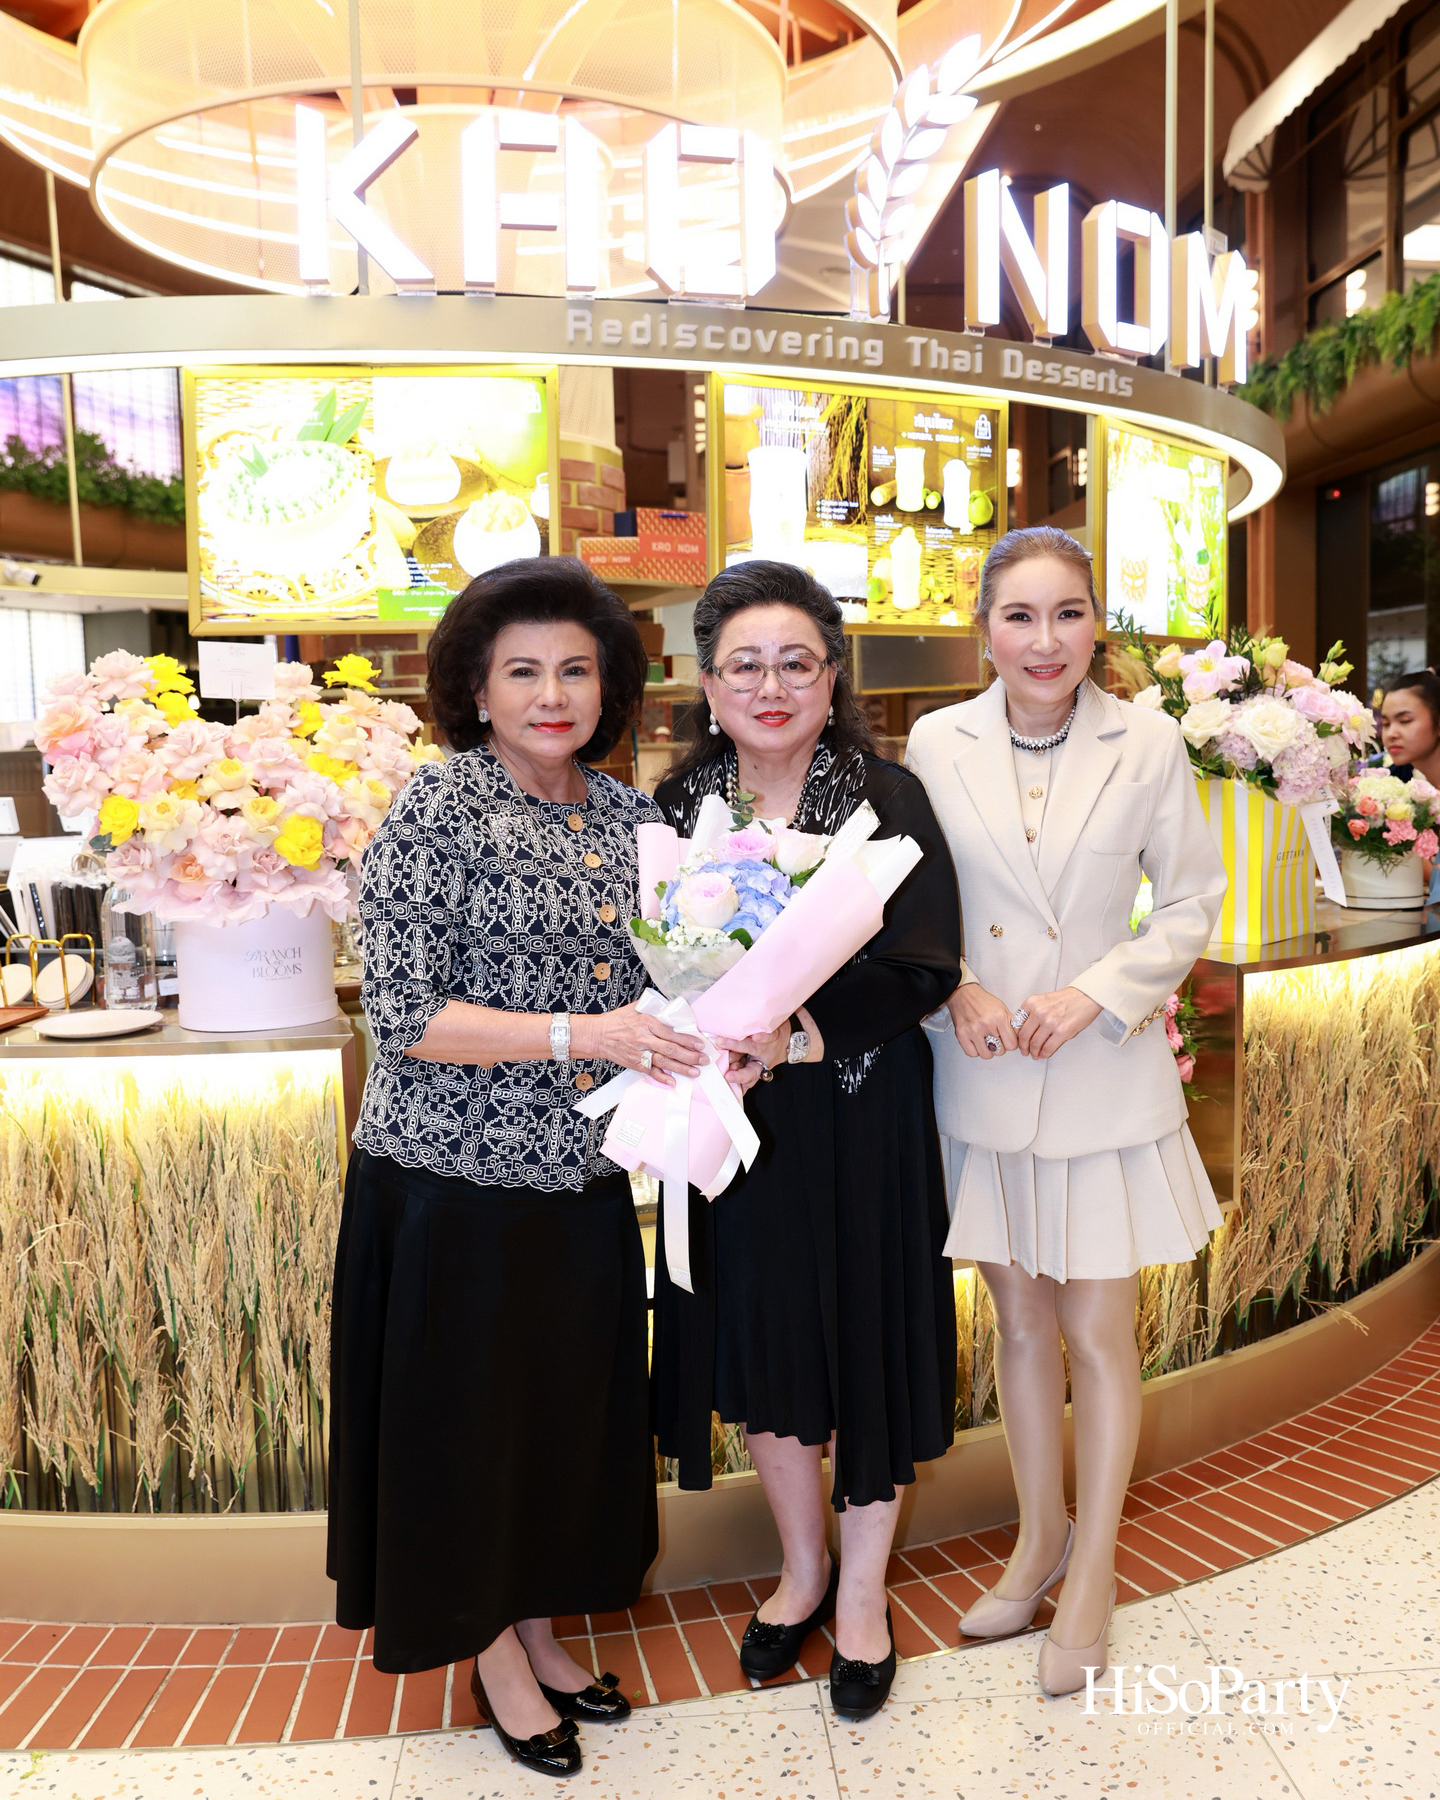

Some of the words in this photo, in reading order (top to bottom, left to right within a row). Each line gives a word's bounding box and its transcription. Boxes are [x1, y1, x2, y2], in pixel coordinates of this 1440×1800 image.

[964, 167, 1248, 386] NOM
[567, 308, 884, 367] Rediscovering
[906, 335, 983, 374] Thai
[1002, 348, 1135, 398] Desserts
[678, 544, 698, 554] NOM
[1276, 849, 1305, 862] GETTAVA
[244, 946, 302, 966] BRANCH
[252, 962, 303, 979] BLOOMS
